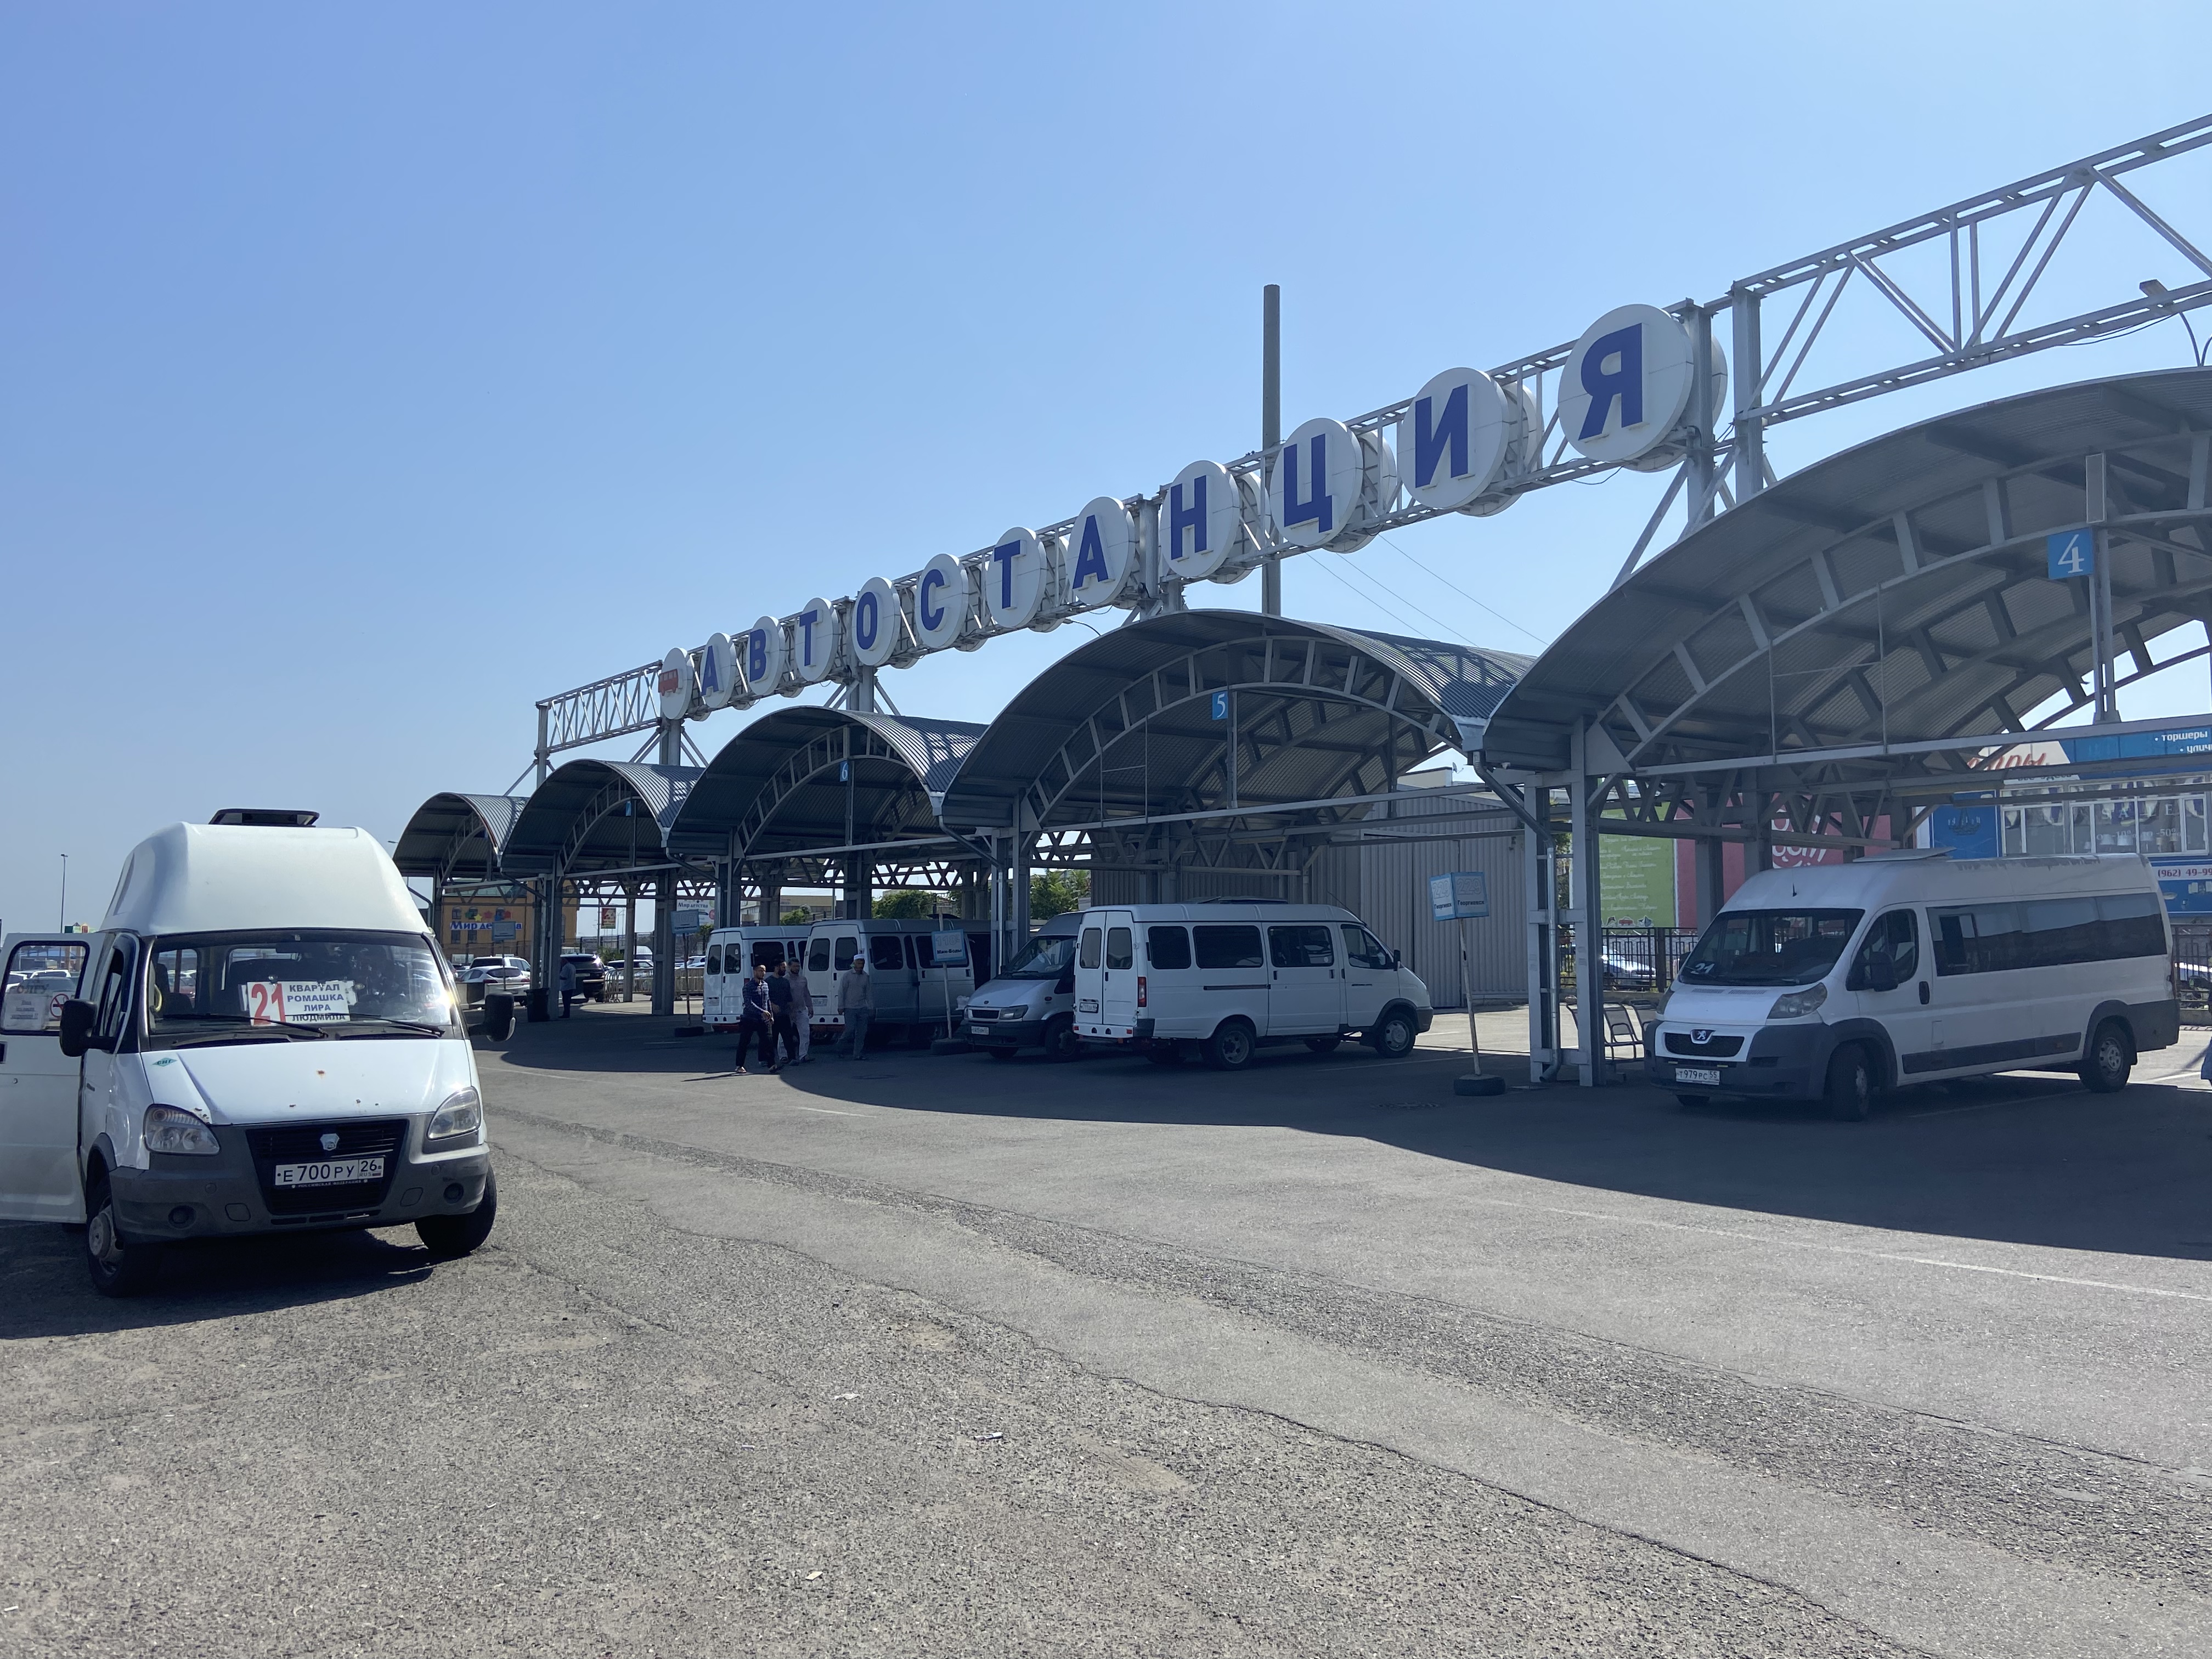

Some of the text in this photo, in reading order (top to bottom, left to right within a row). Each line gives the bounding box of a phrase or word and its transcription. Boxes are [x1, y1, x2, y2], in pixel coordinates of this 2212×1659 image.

[701, 323, 1643, 697] АВТОСТАНЦИЯ
[2058, 534, 2084, 574] 4
[1217, 693, 1226, 718] 5
[2162, 731, 2208, 742] торшеры
[842, 763, 848, 780] 6
[2158, 868, 2181, 877] (962)
[1432, 880, 1449, 899] 229
[1457, 878, 1481, 895] 229
[450, 921, 477, 930] Мир
[1690, 963, 1715, 974] 21
[290, 984, 340, 992] КВАРТАЛ
[251, 983, 286, 1025] 21
[287, 994, 344, 1002] РОМАШКА
[292, 1014, 346, 1022] ЛЮДМИЛА
[1679, 1070, 1707, 1080] Т979РС
[283, 1160, 377, 1182] Е700РУ 26
